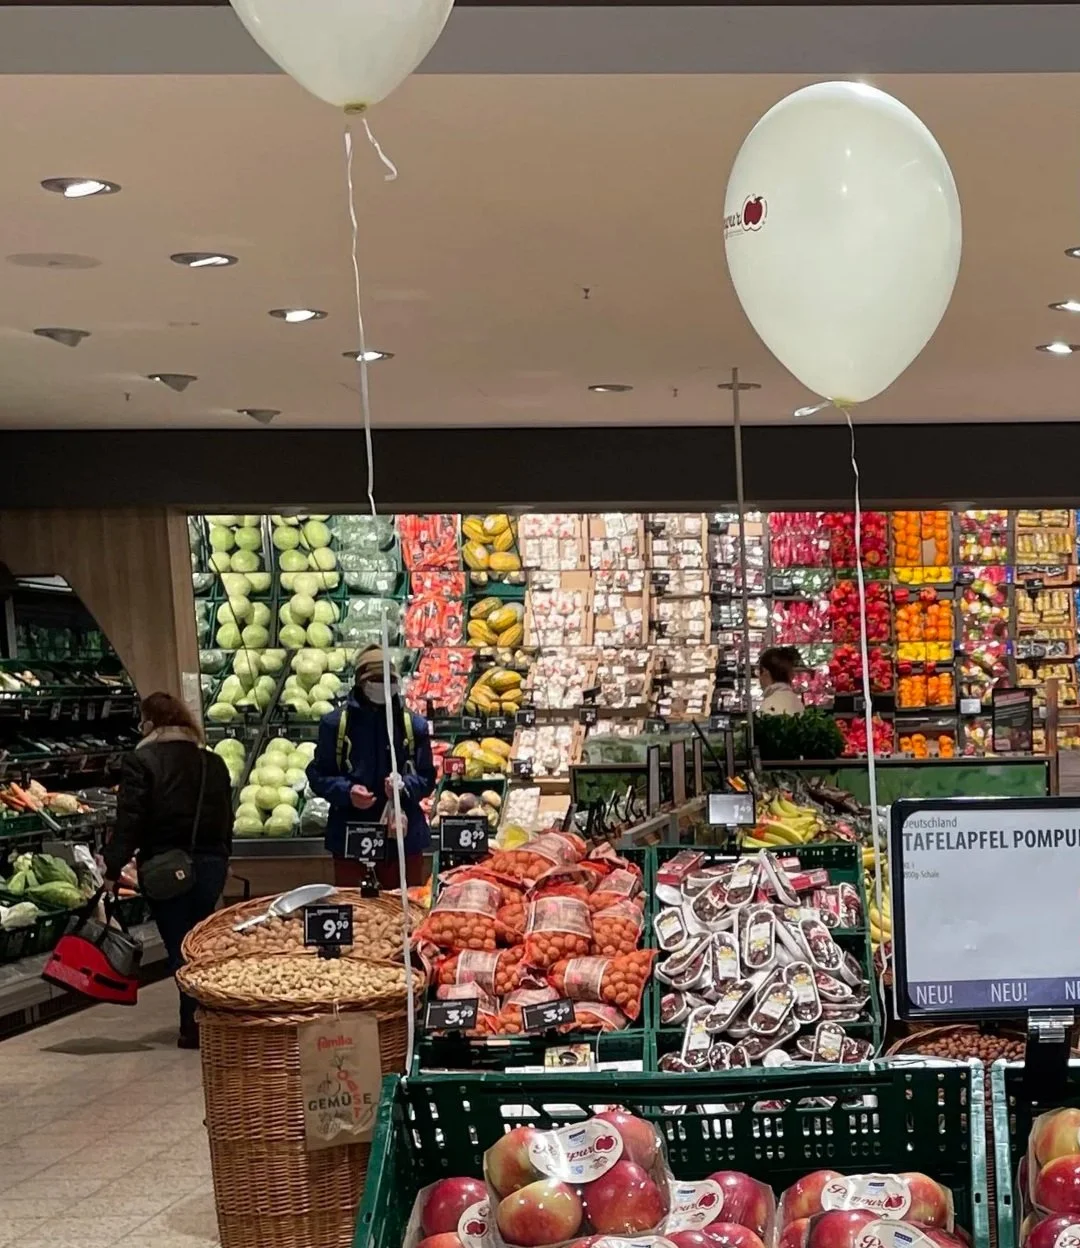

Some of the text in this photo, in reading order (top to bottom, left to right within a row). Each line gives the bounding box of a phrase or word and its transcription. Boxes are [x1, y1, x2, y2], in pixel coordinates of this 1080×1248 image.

[903, 831, 1008, 851] TAFELAPFEL
[916, 985, 954, 1005] NEU!
[991, 982, 1028, 1002] NEU!
